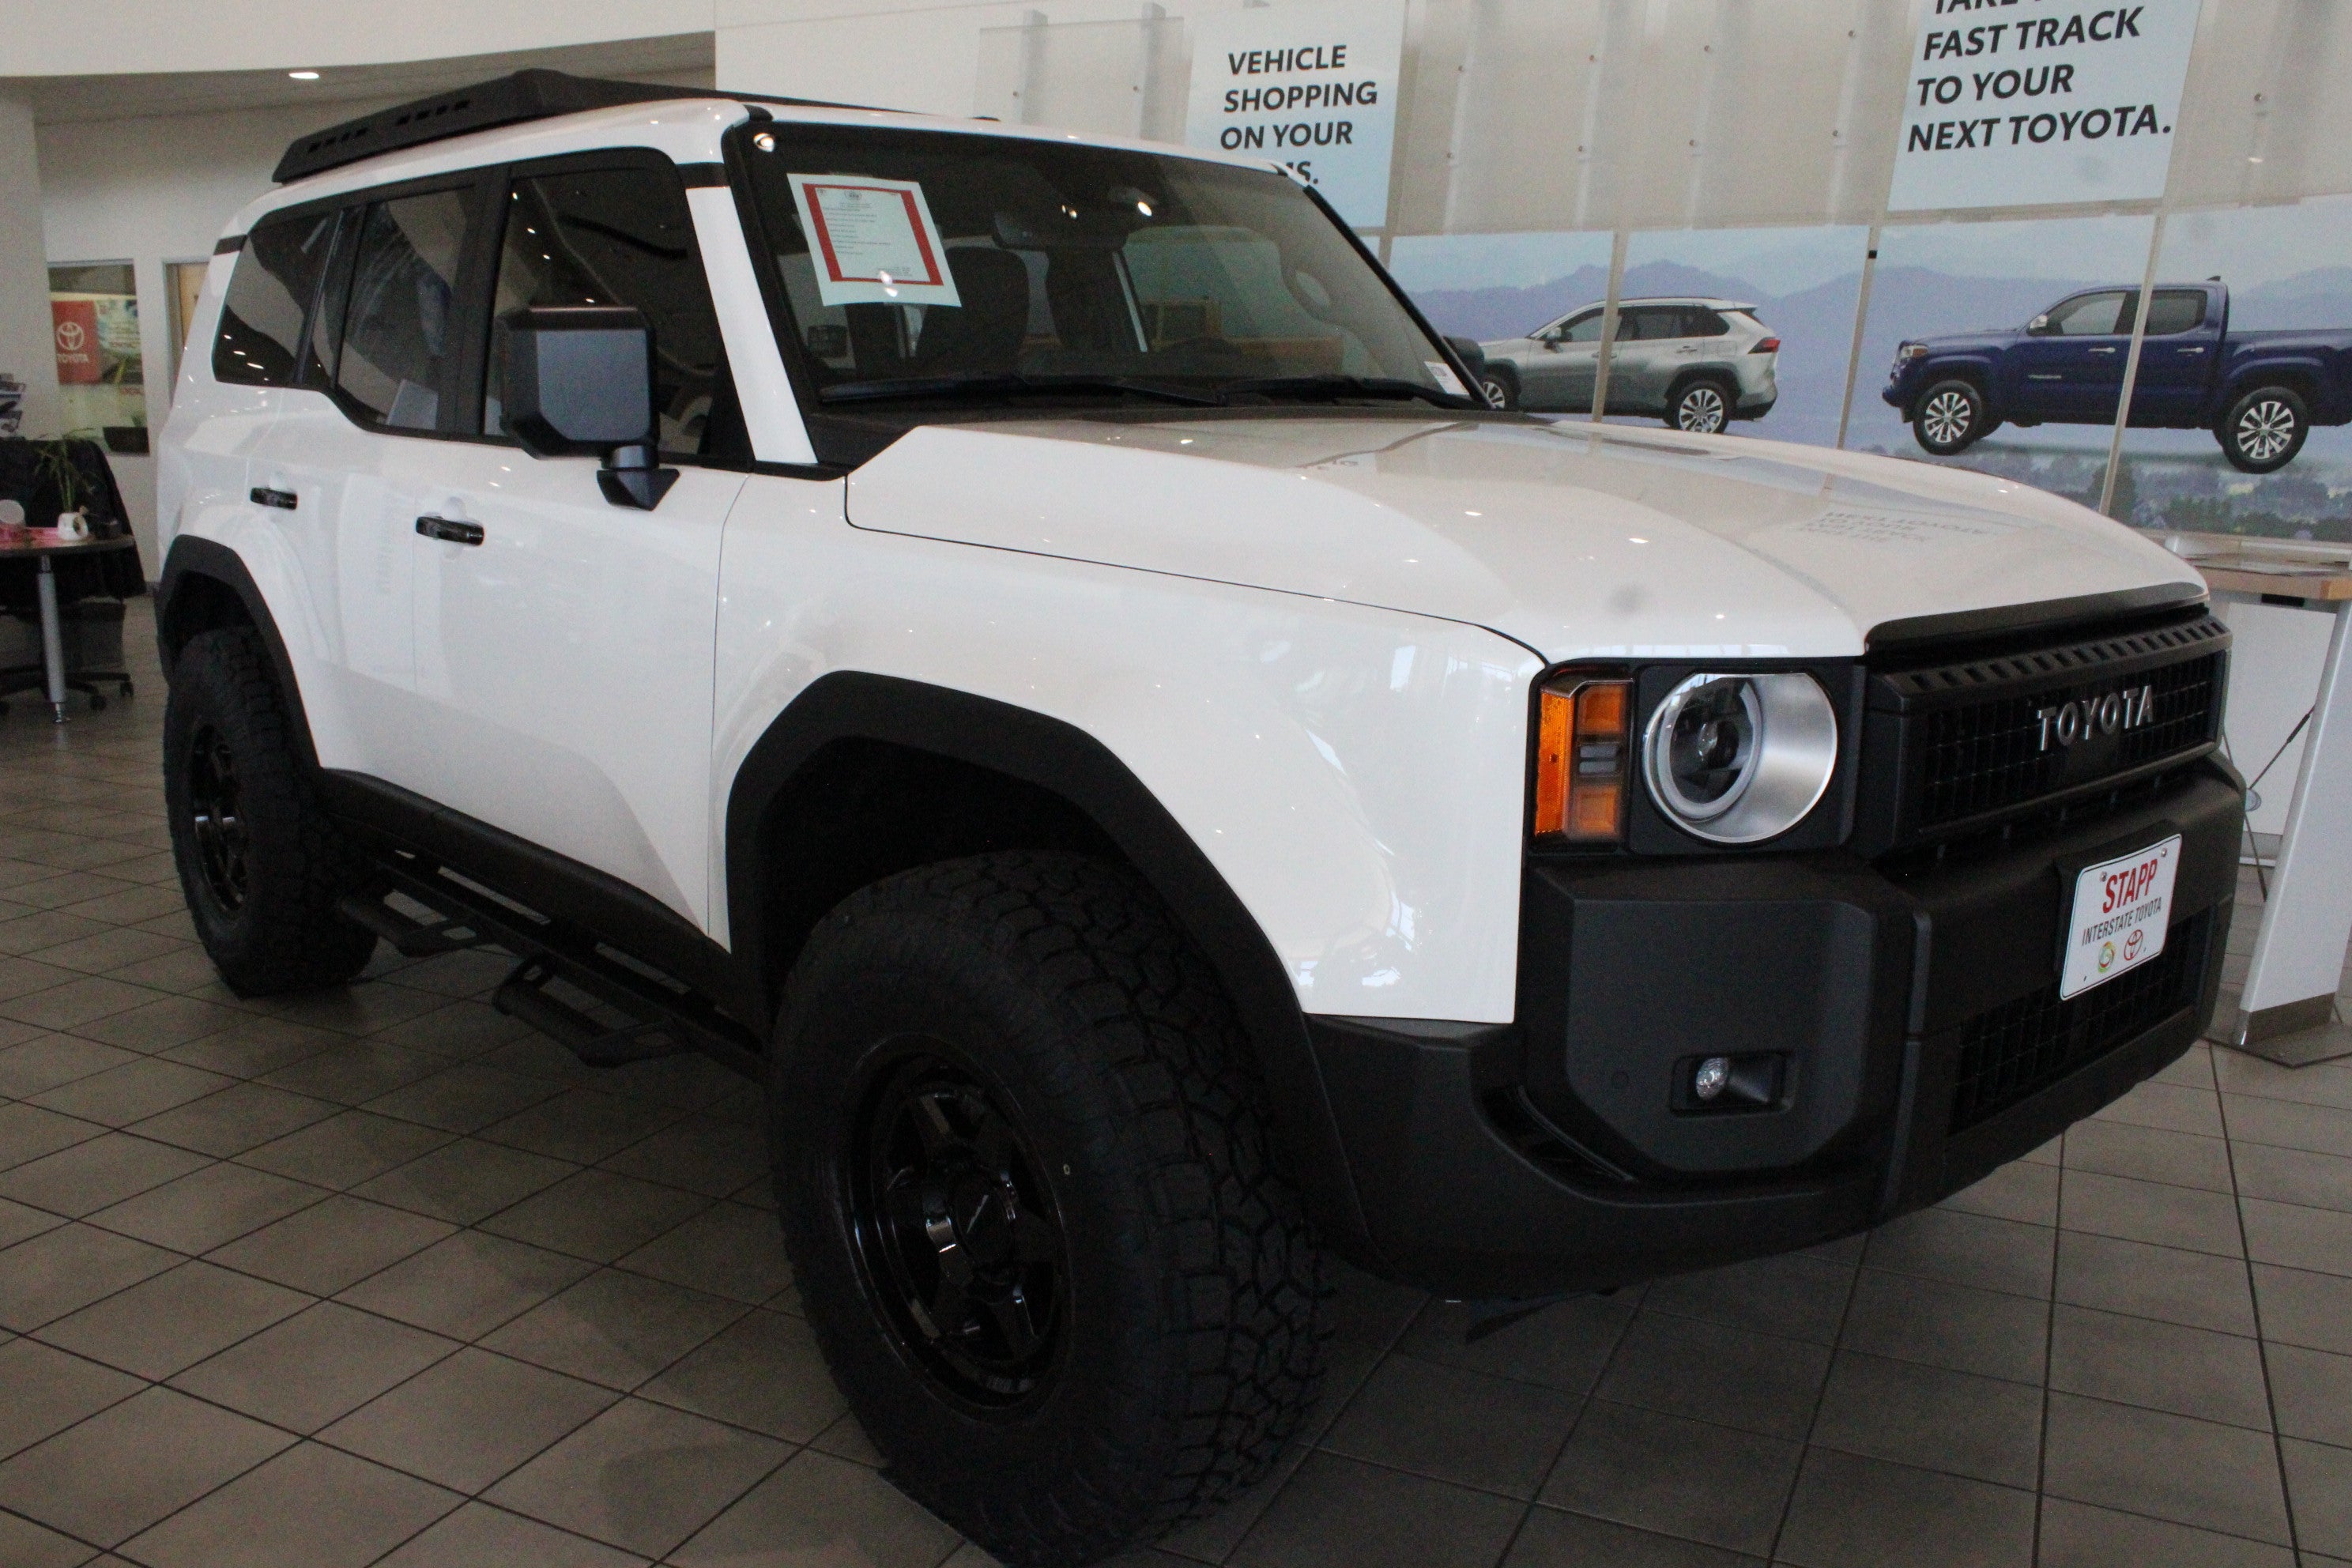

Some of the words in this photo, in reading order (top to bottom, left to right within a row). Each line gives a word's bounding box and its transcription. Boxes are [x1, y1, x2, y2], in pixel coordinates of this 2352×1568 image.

[1924, 24, 2007, 61] FAST
[2016, 6, 2144, 51] TRACK
[1228, 44, 1347, 75] VEHICLE
[1223, 81, 1378, 113] SHOPPING
[1917, 75, 1962, 106] TO
[1973, 63, 2075, 101] YOUR
[1220, 126, 1265, 150] ON
[1272, 121, 1353, 148] YOUR
[1907, 117, 2000, 153] NEXT
[2009, 104, 2172, 145] TOYOTA.
[2037, 684, 2154, 751] TOYOTA
[2102, 858, 2158, 914] STAPP
[2082, 910, 2134, 946] INTERSTATE
[2135, 896, 2162, 924] TOYOTA
